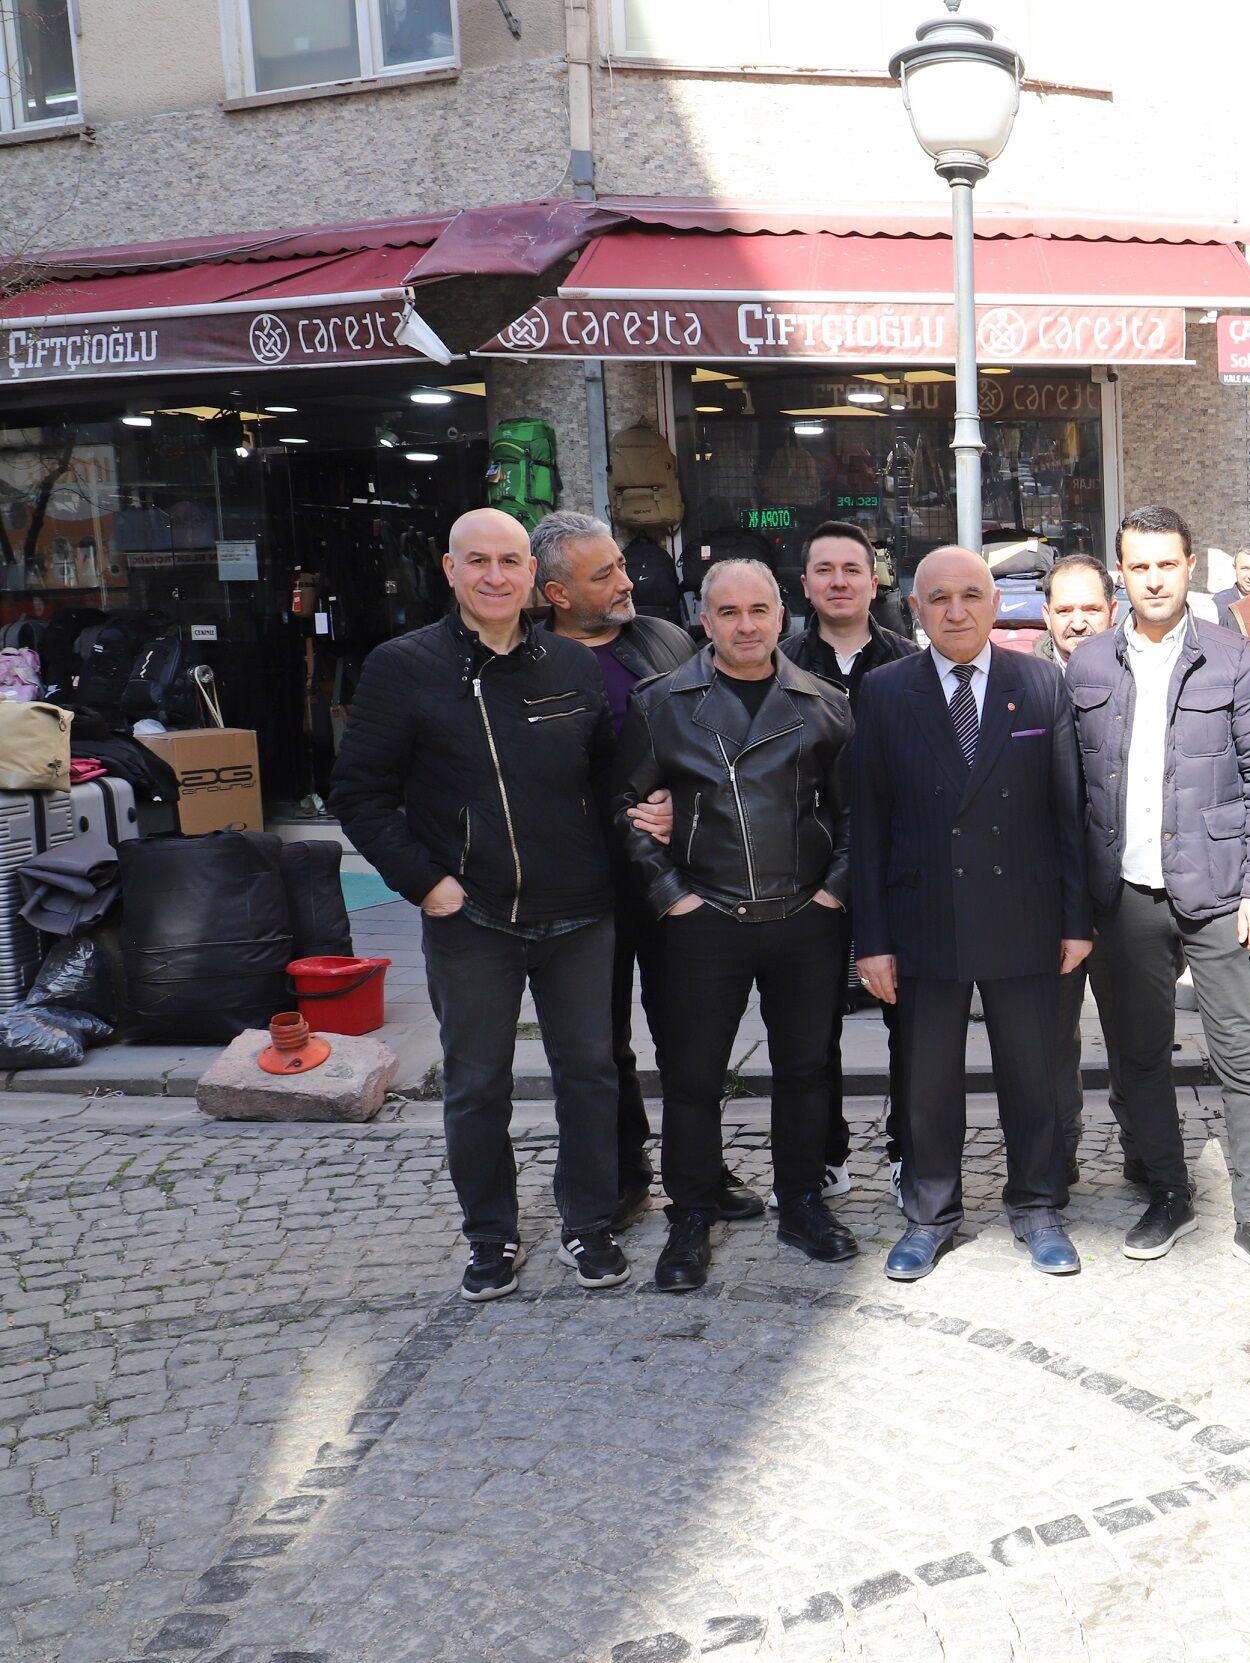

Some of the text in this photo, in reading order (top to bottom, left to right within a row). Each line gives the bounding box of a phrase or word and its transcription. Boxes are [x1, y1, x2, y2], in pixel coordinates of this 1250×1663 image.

[8, 325, 158, 378] ÇİFTÇİOĞLU
[737, 303, 945, 354] ÇİFTÇİOĞLU
[1223, 374, 1241, 383] KALE
